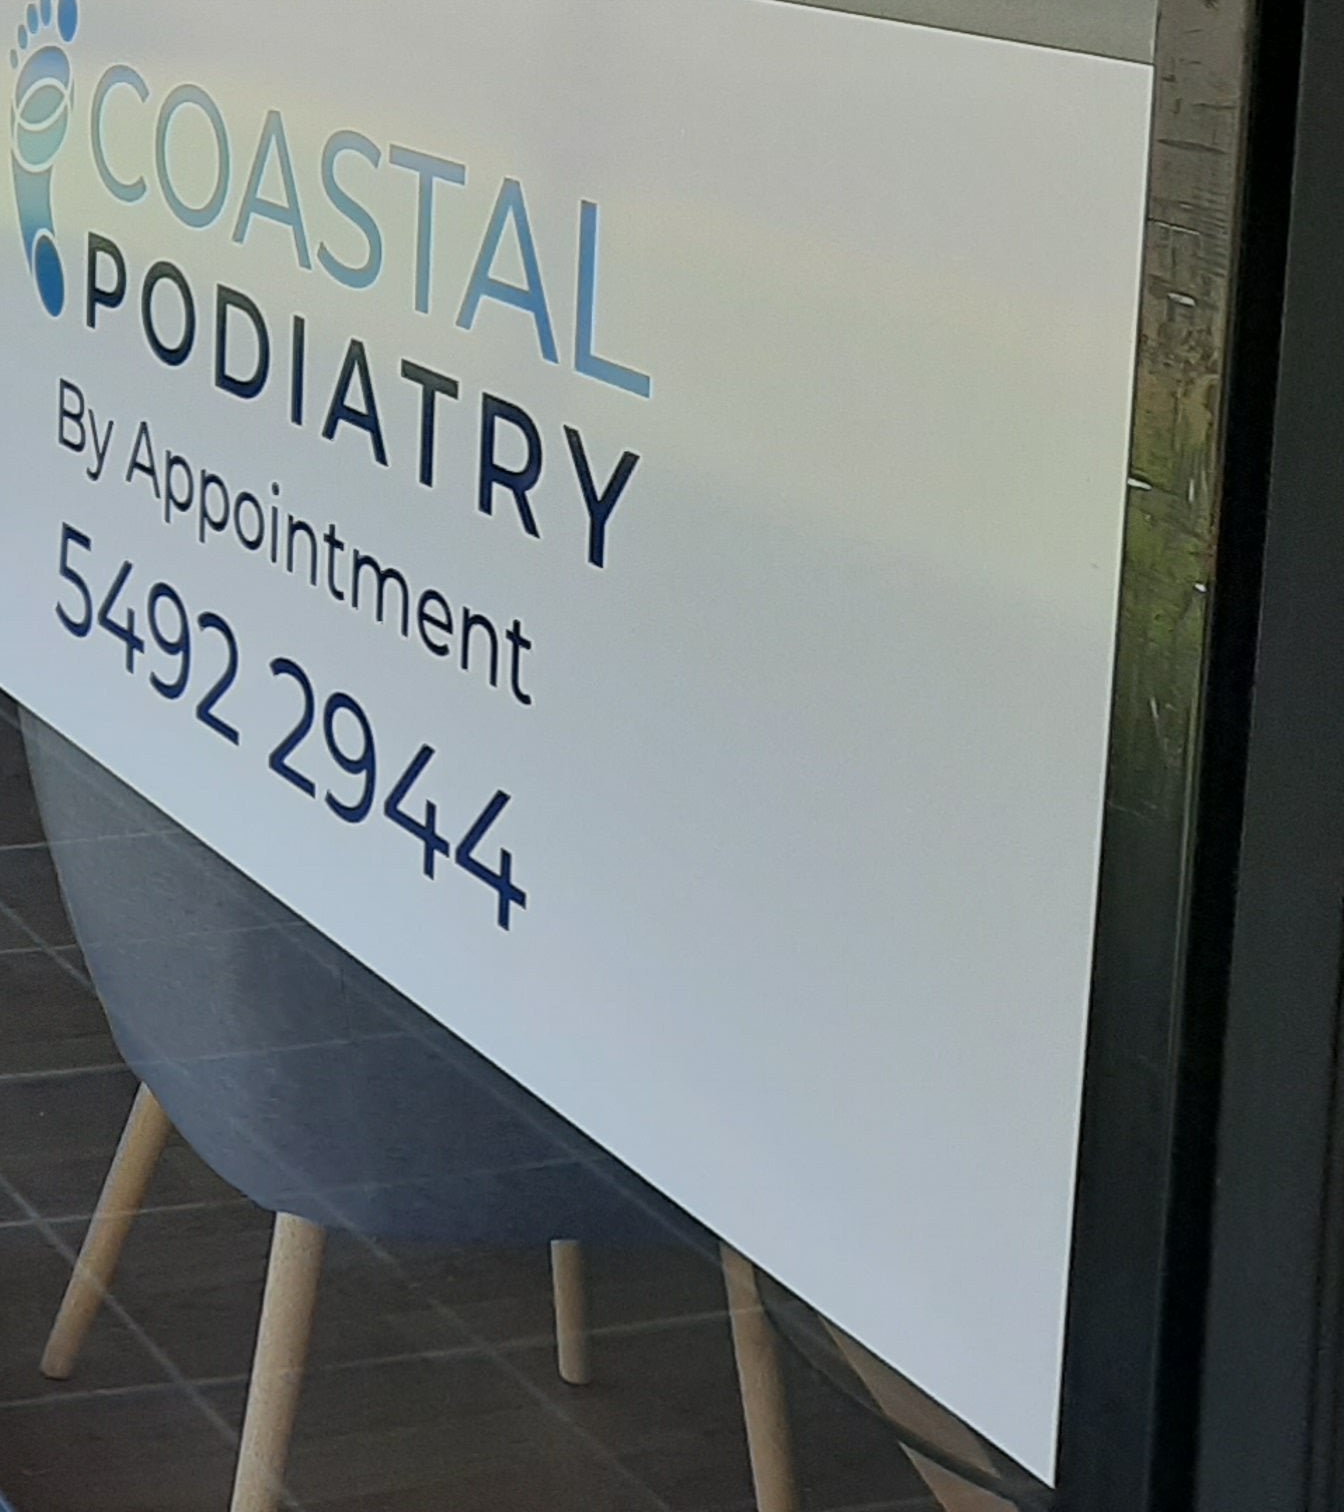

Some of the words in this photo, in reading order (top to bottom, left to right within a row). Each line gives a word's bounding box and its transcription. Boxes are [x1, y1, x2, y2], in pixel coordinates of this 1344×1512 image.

[86, 230, 641, 570] PODIATRY
[90, 64, 652, 399] COASTAL
[58, 377, 114, 482] By
[124, 420, 533, 707] Appointment
[54, 520, 240, 748] 5492
[267, 656, 528, 933] 2944
